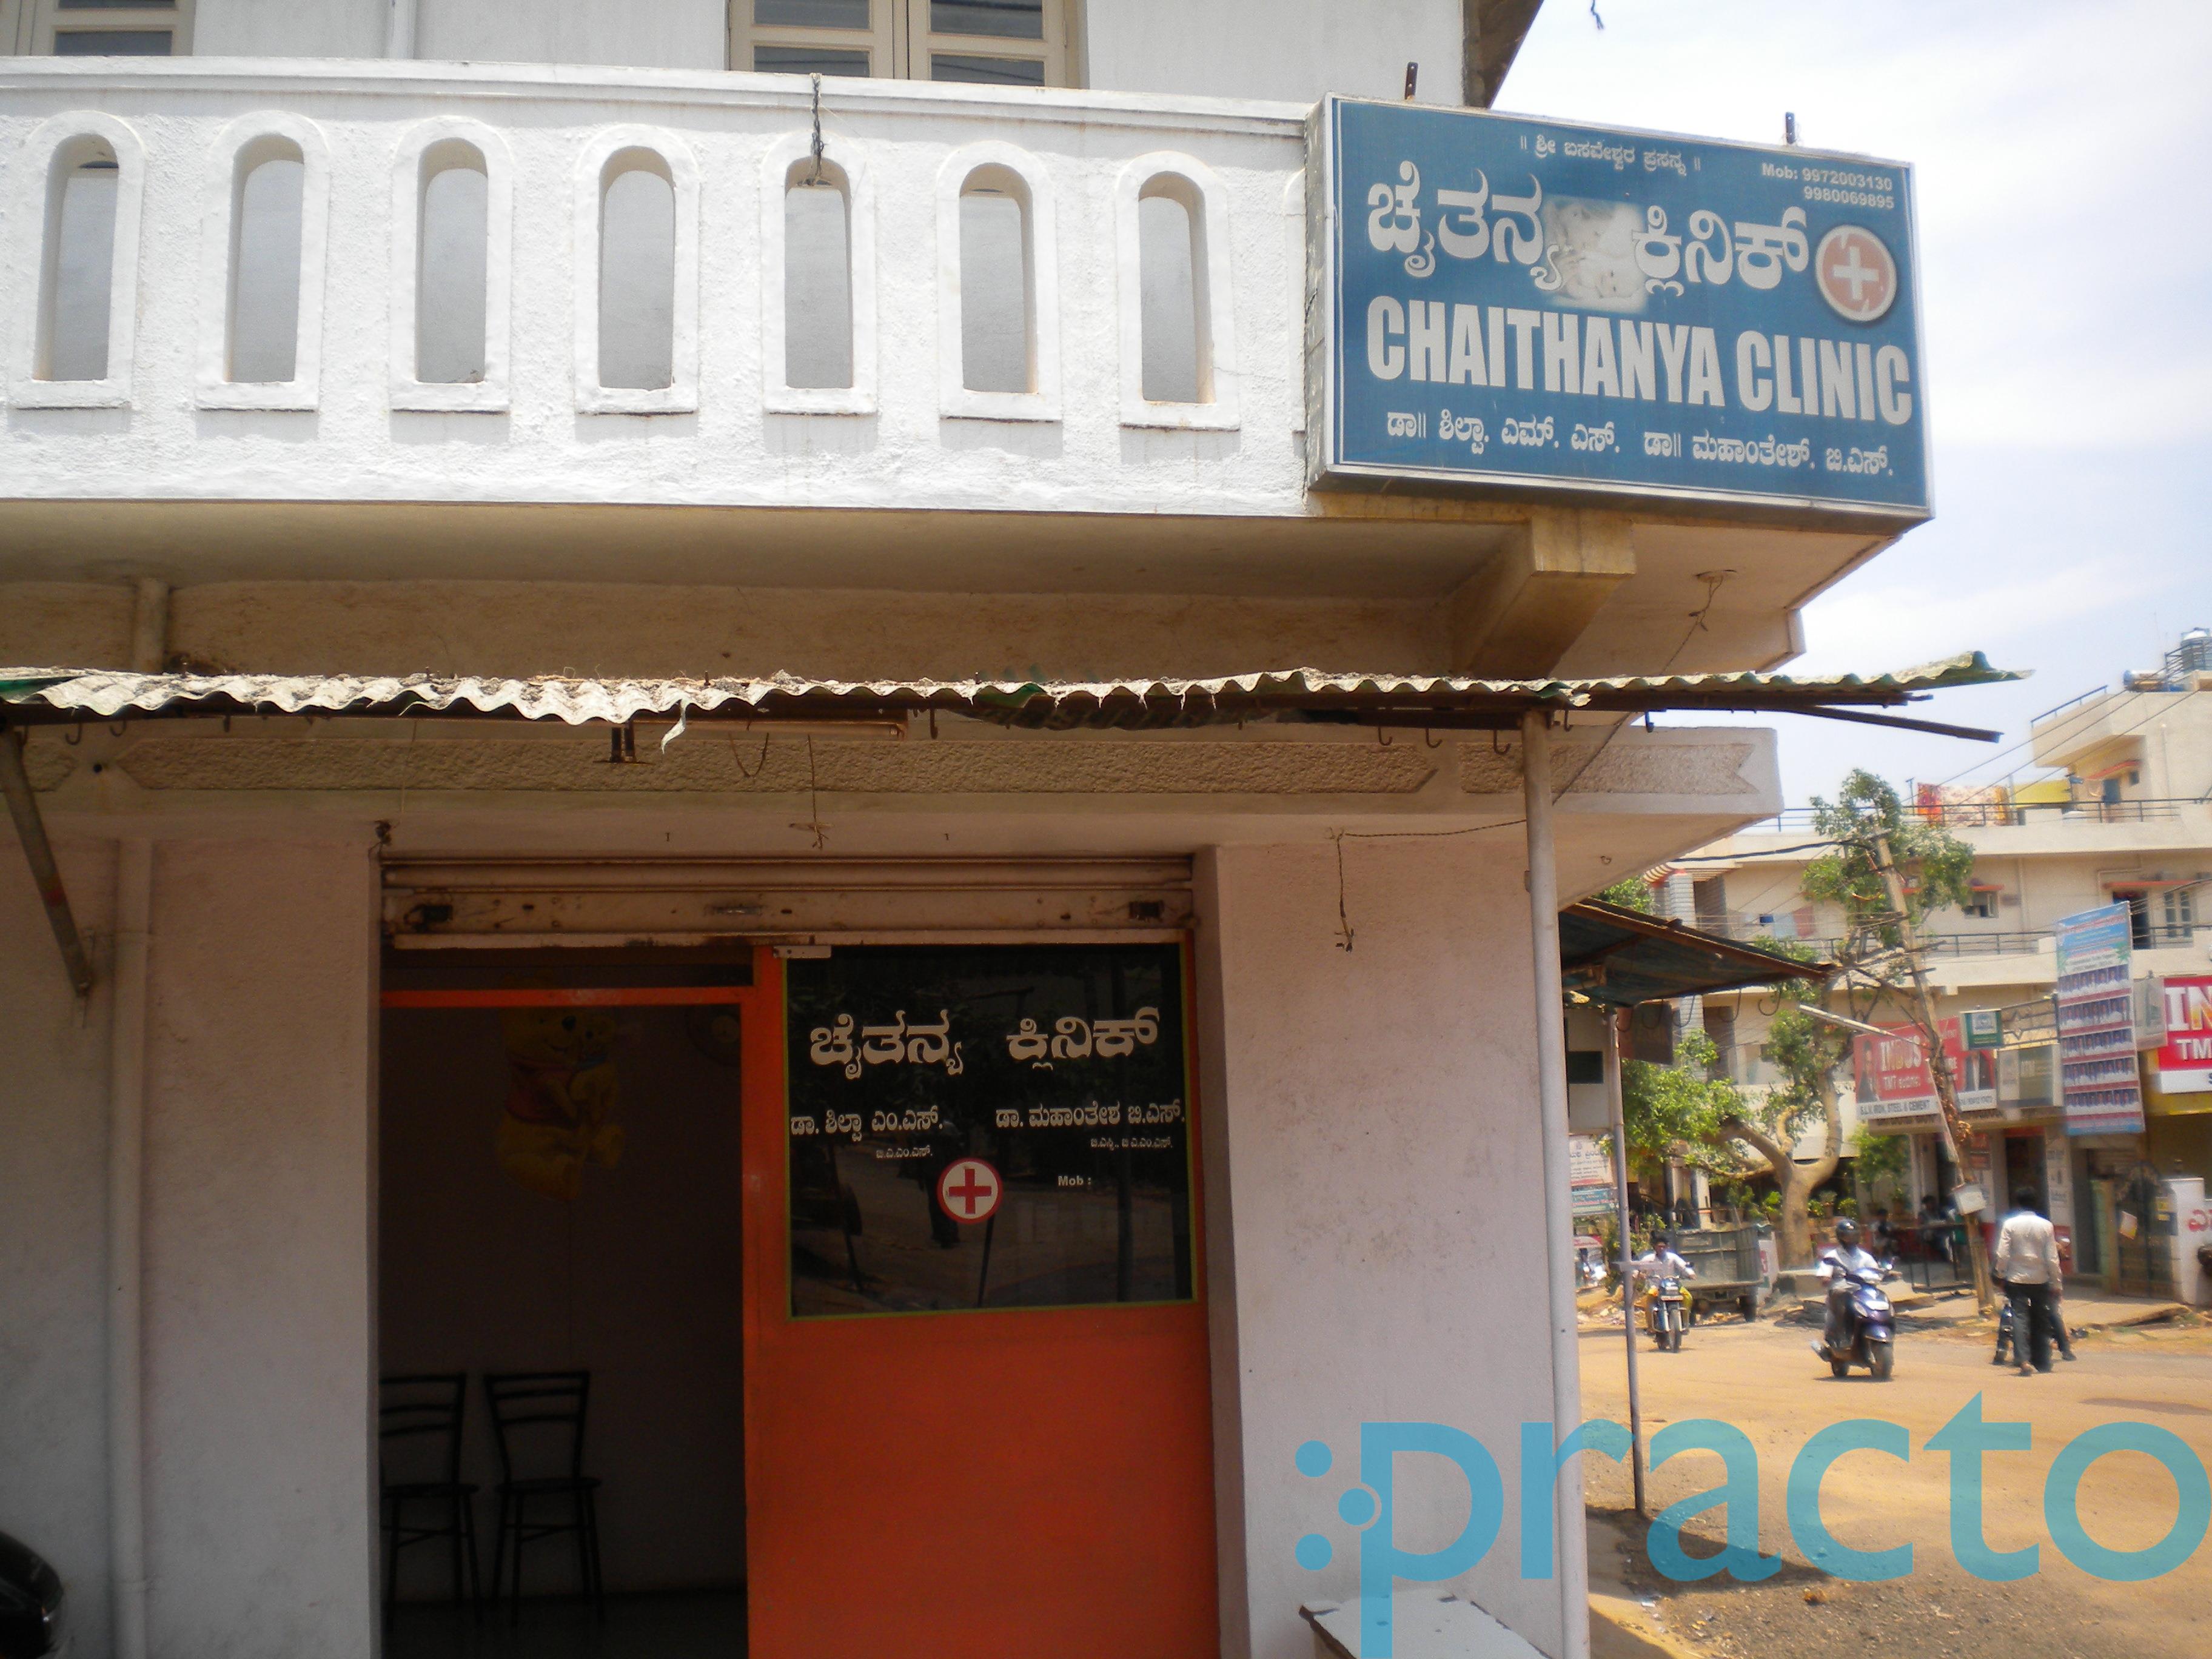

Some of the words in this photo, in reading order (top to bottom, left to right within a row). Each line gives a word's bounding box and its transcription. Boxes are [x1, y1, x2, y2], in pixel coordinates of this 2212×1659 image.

[1535, 134, 1556, 159] ಶ್ರೀ
[1564, 139, 1635, 171] ಬಸವೇಶ್ವರ
[1643, 150, 1687, 177] ಪ್ರಸನ್ನ
[1761, 162, 1798, 180] Mob:
[1801, 167, 1893, 192] 9972003130
[1367, 160, 1563, 292] ಚೈತನ್ಯ
[1632, 204, 1810, 297] ಕ್ಲಿನಿಕ್
[1367, 295, 1726, 407] CHAITHANYA
[1735, 330, 1913, 426] CLINIC
[810, 1009, 964, 1080] ಚೈತನ್ಯ
[1006, 1007, 1160, 1071] ಕ್ಲಿನಿಕ್
[791, 1116, 819, 1135] ಡಾ.
[871, 1105, 943, 1131] ಎಂ.ಎಸ್.
[996, 1109, 1024, 1127] ಡಾ.
